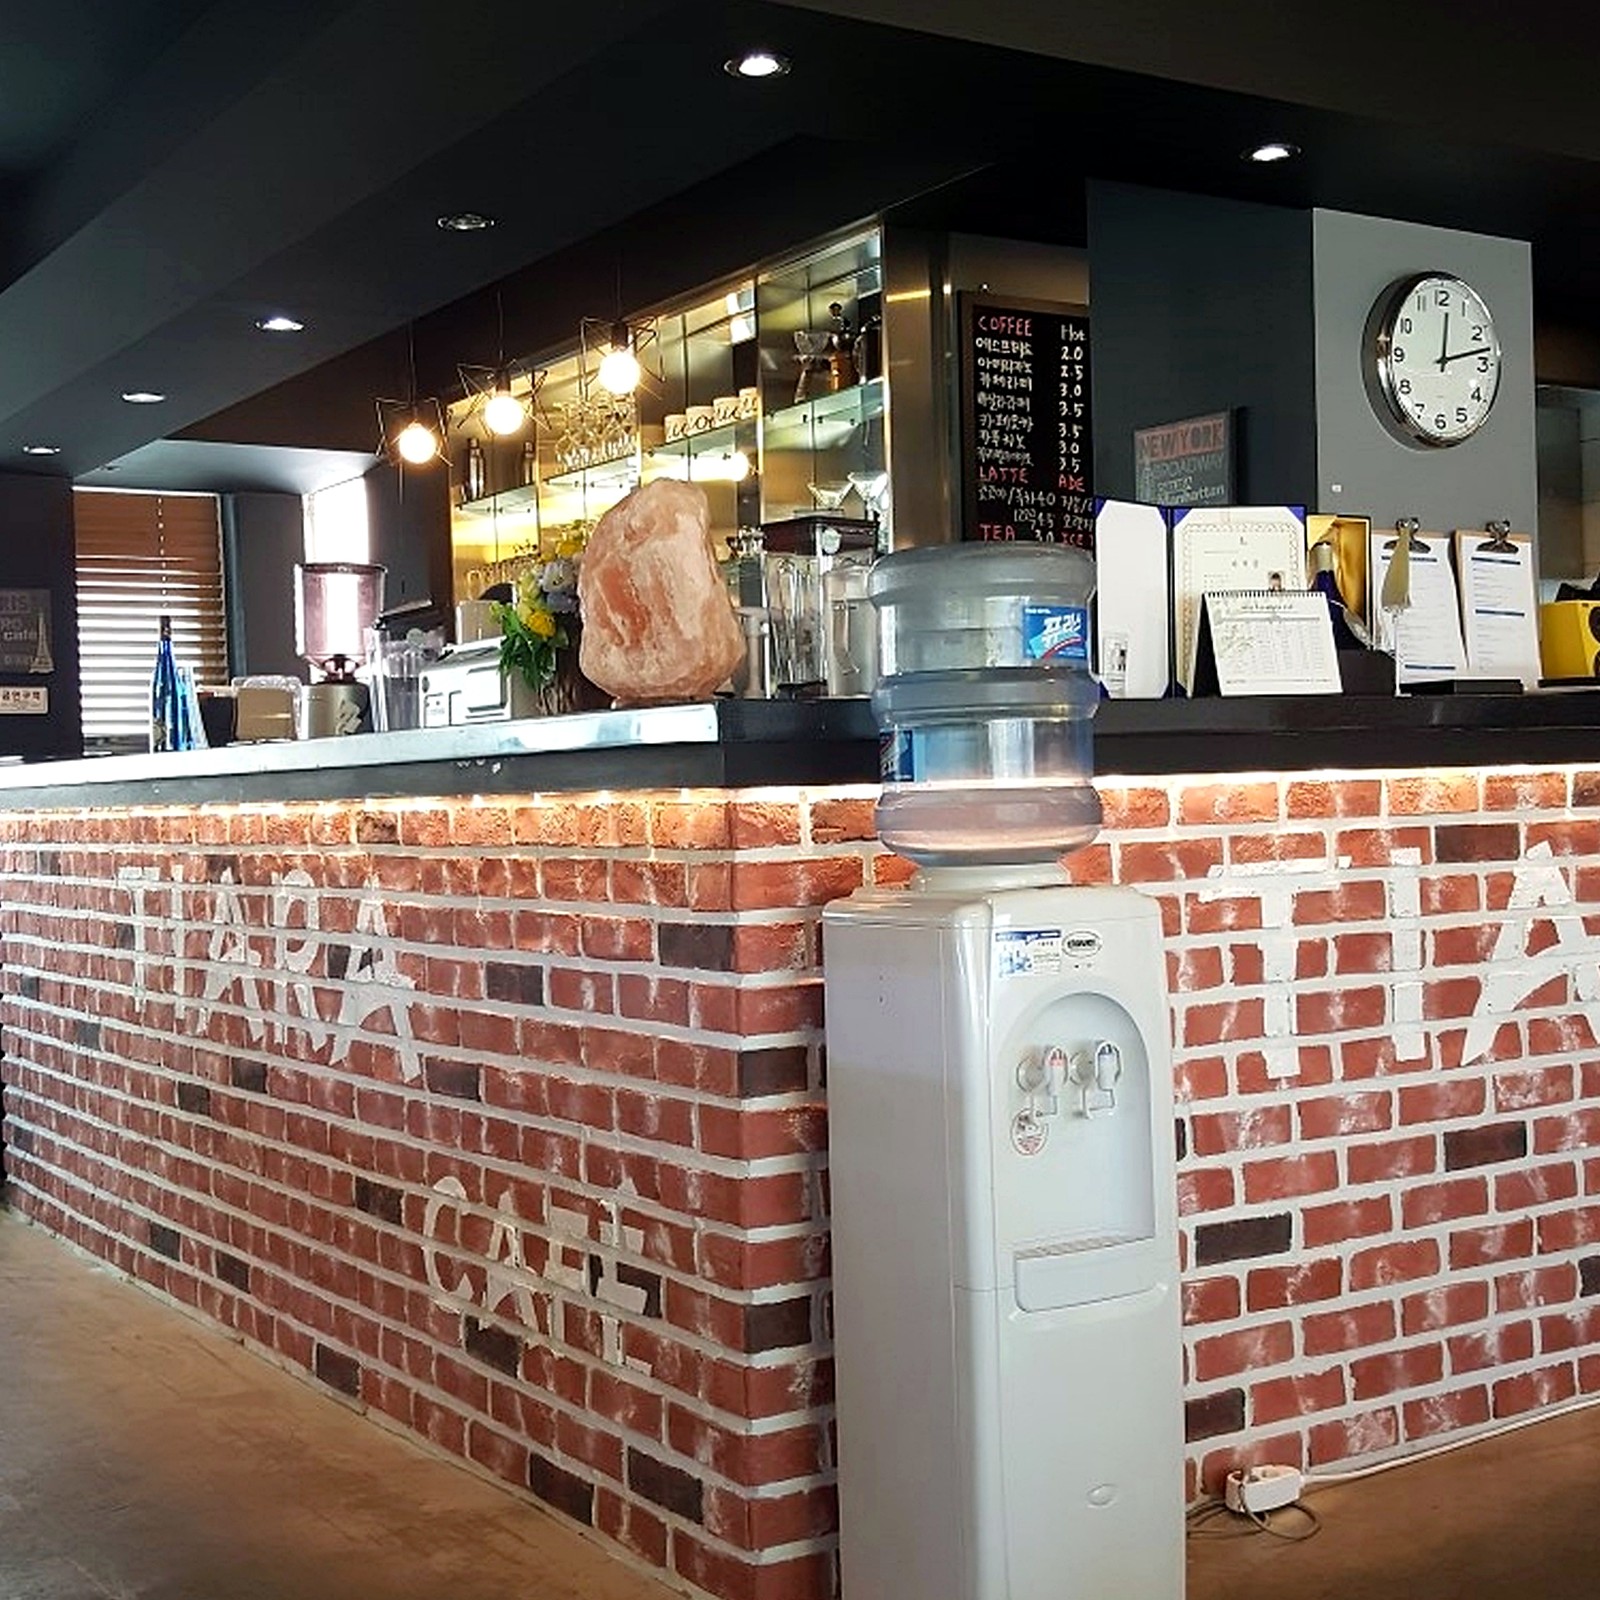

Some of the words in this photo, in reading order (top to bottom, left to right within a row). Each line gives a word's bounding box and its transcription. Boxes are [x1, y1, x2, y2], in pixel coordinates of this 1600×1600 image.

[1417, 295, 1427, 311] 11
[1434, 290, 1450, 307] 12
[978, 315, 1033, 337] COFFEE
[1400, 318, 1412, 334] 10
[1471, 326, 1482, 341] 2
[1061, 345, 1084, 361] 2.0
[1394, 347, 1405, 362] 9
[1477, 356, 1489, 373] 3
[1059, 382, 1082, 399] 3.0
[1400, 379, 1412, 395] 8
[1471, 387, 1481, 402] 4
[1059, 400, 1085, 418] 3.5
[1415, 403, 1425, 419] 7
[1456, 407, 1468, 423] 5
[1435, 414, 1446, 429] 6
[1058, 422, 1084, 439] 3.5
[1058, 440, 1080, 454] 3.0
[1059, 456, 1082, 473] 3.5
[979, 466, 1028, 484] LATTE
[1058, 474, 1085, 492] ADE
[979, 523, 1015, 541] TEA
[117, 864, 424, 1084] TIARA
